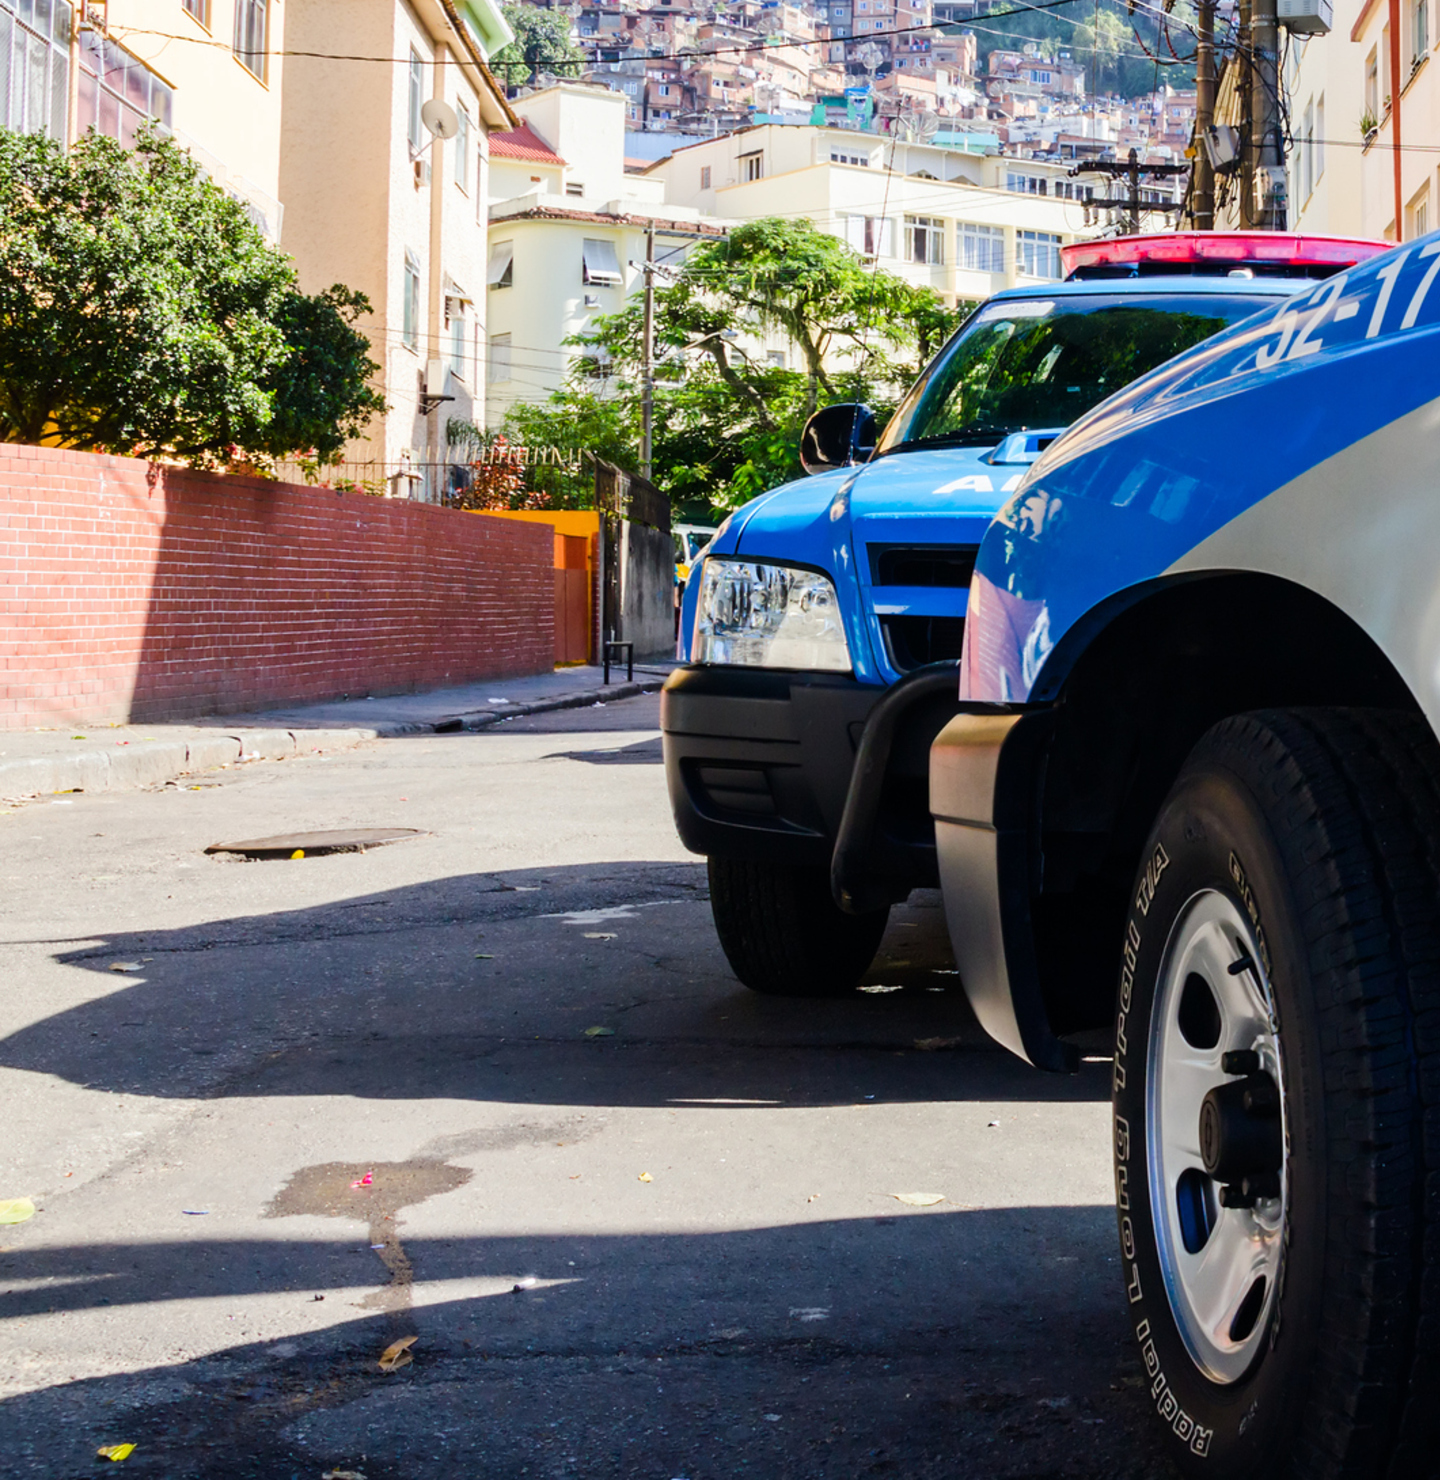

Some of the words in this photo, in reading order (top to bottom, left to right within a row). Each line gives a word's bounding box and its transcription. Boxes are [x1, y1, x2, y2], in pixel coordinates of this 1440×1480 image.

[1113, 919, 1142, 1093] Trail
[1114, 1115, 1143, 1304] Long
[1136, 1318, 1213, 1459] Radial
